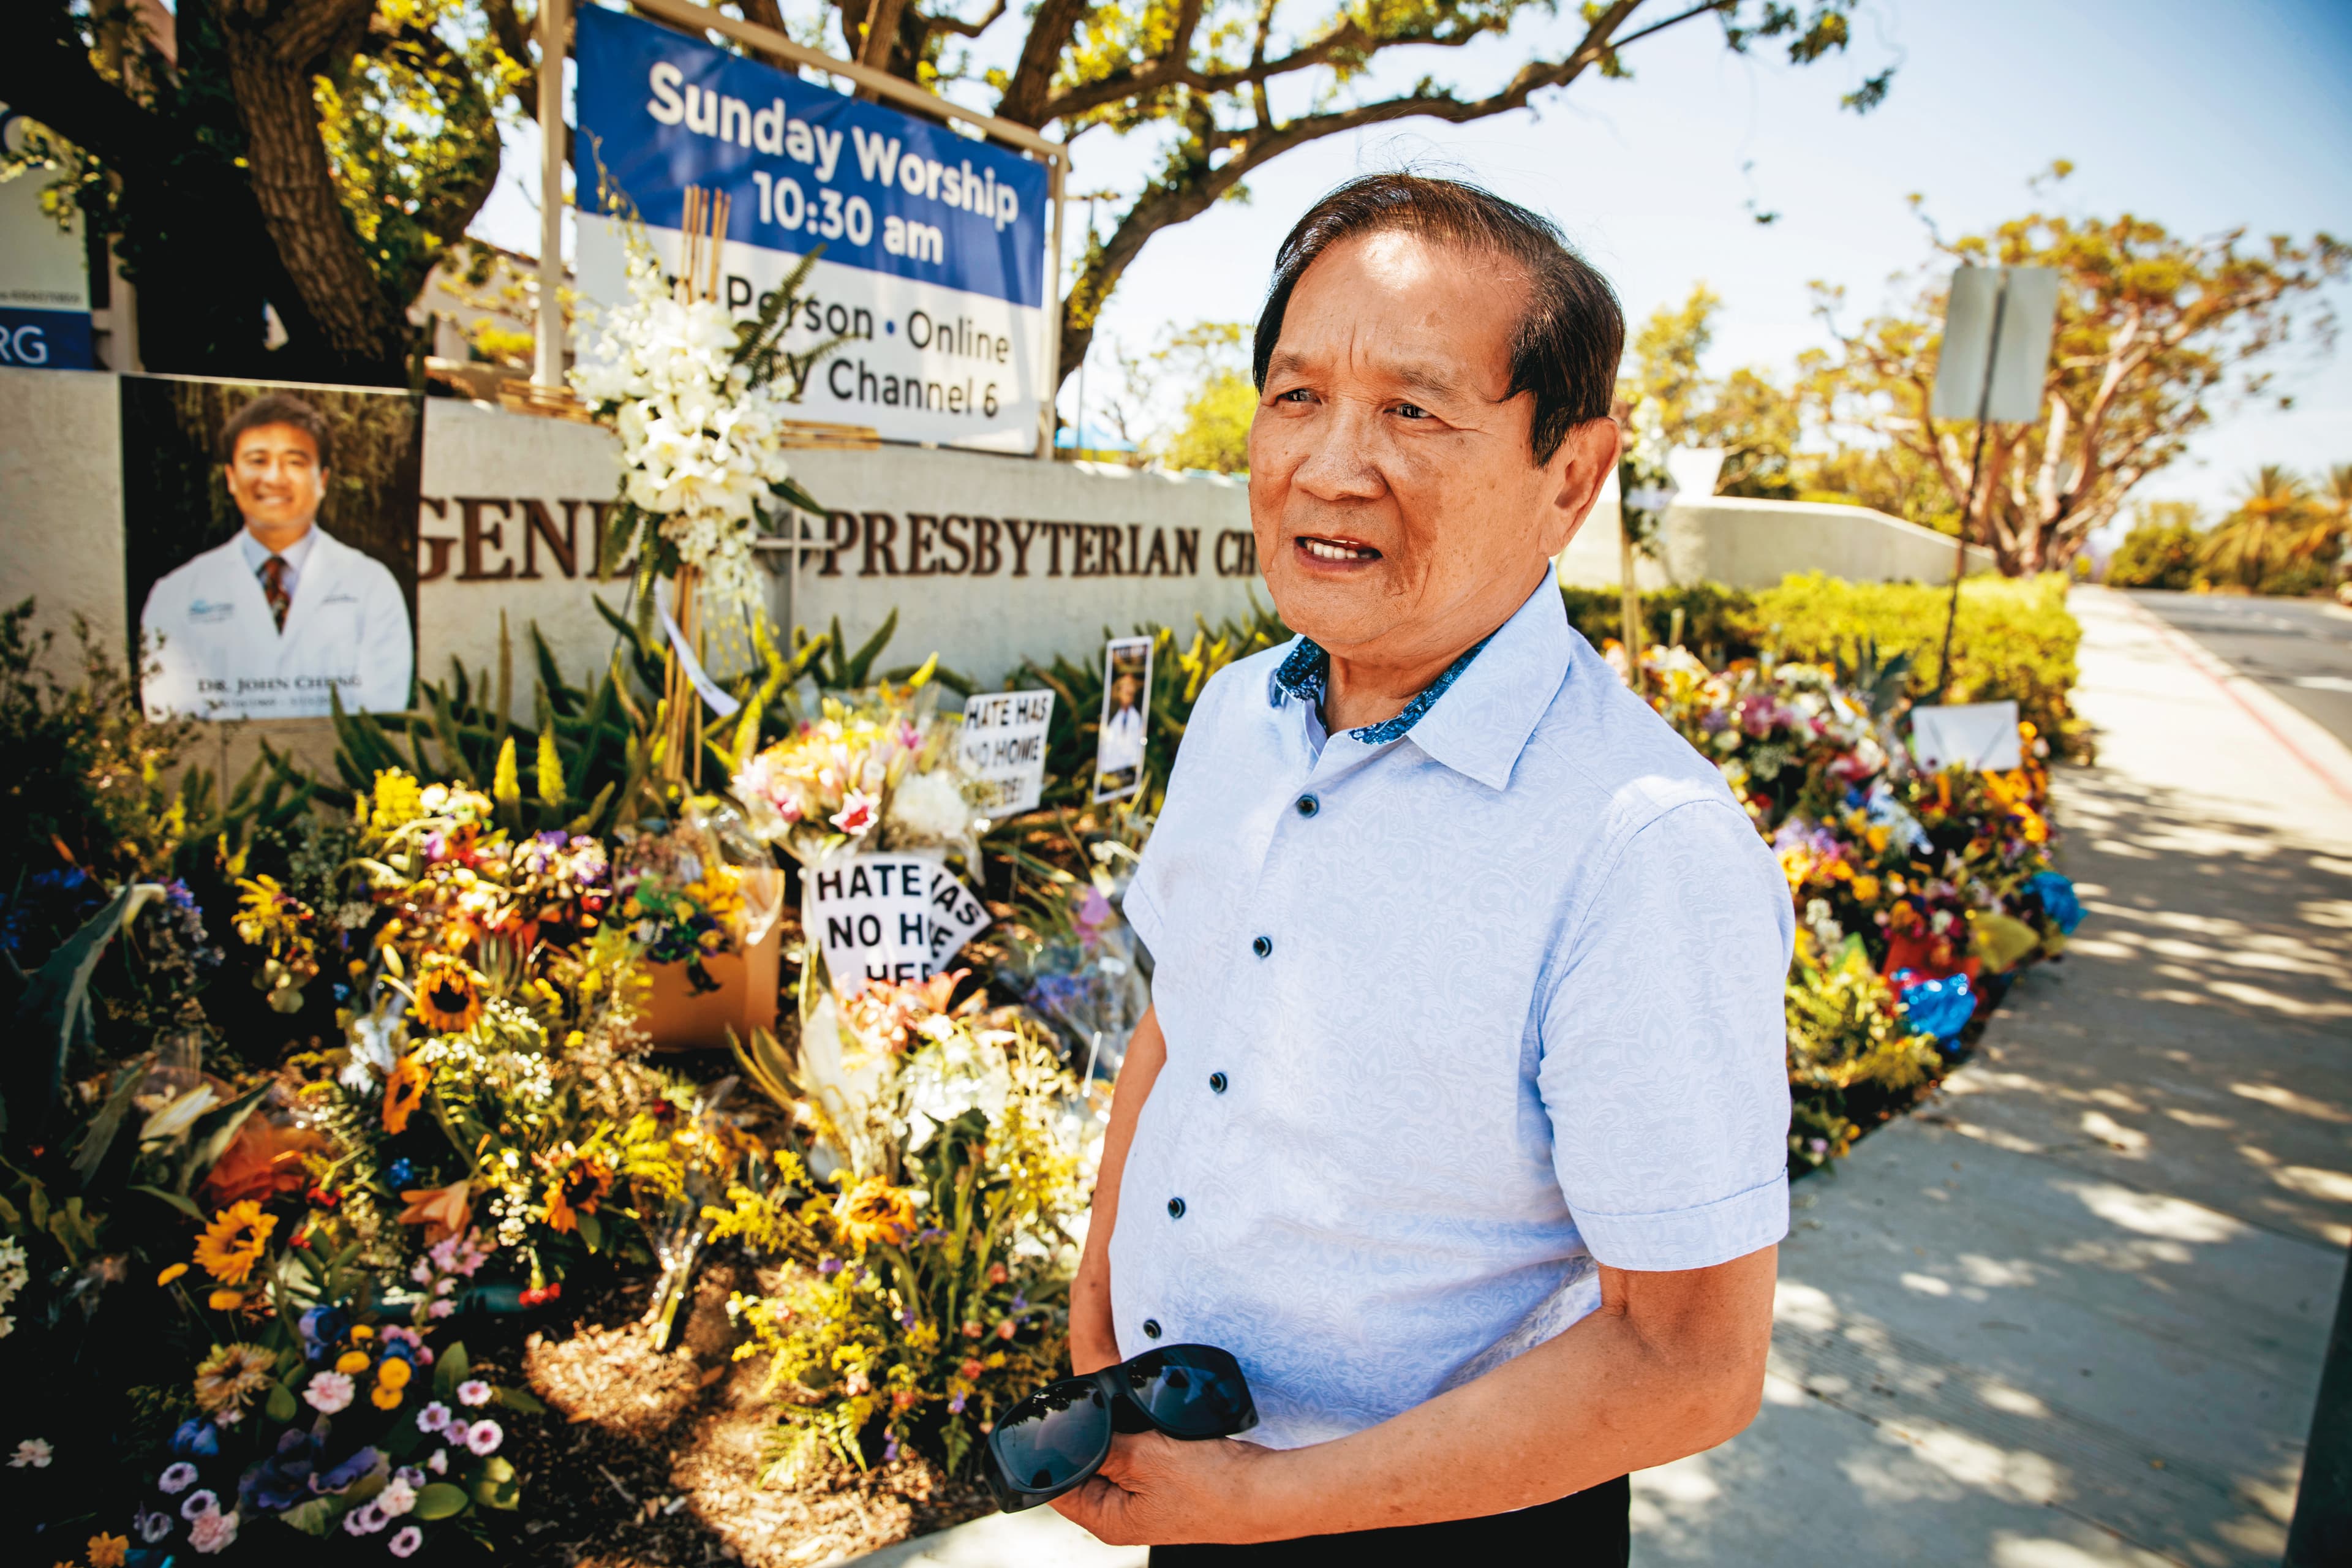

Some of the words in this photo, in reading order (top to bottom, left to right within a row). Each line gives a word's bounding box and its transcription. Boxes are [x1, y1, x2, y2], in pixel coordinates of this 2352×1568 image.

[646, 61, 843, 183] Sunday
[851, 126, 1019, 230] Worship
[753, 172, 873, 246] 10:30
[883, 216, 944, 265] am
[907, 311, 1009, 363] Online
[828, 360, 974, 415] Channel
[983, 383, 1000, 418] 6
[817, 510, 1200, 577] PRESBYTERIAN
[238, 677, 288, 695] JOHN
[966, 699, 1009, 729] HATE
[1016, 696, 1048, 724] HAS
[993, 736, 1041, 766] HOME
[817, 864, 922, 901] HATE
[827, 914, 881, 949] NO
